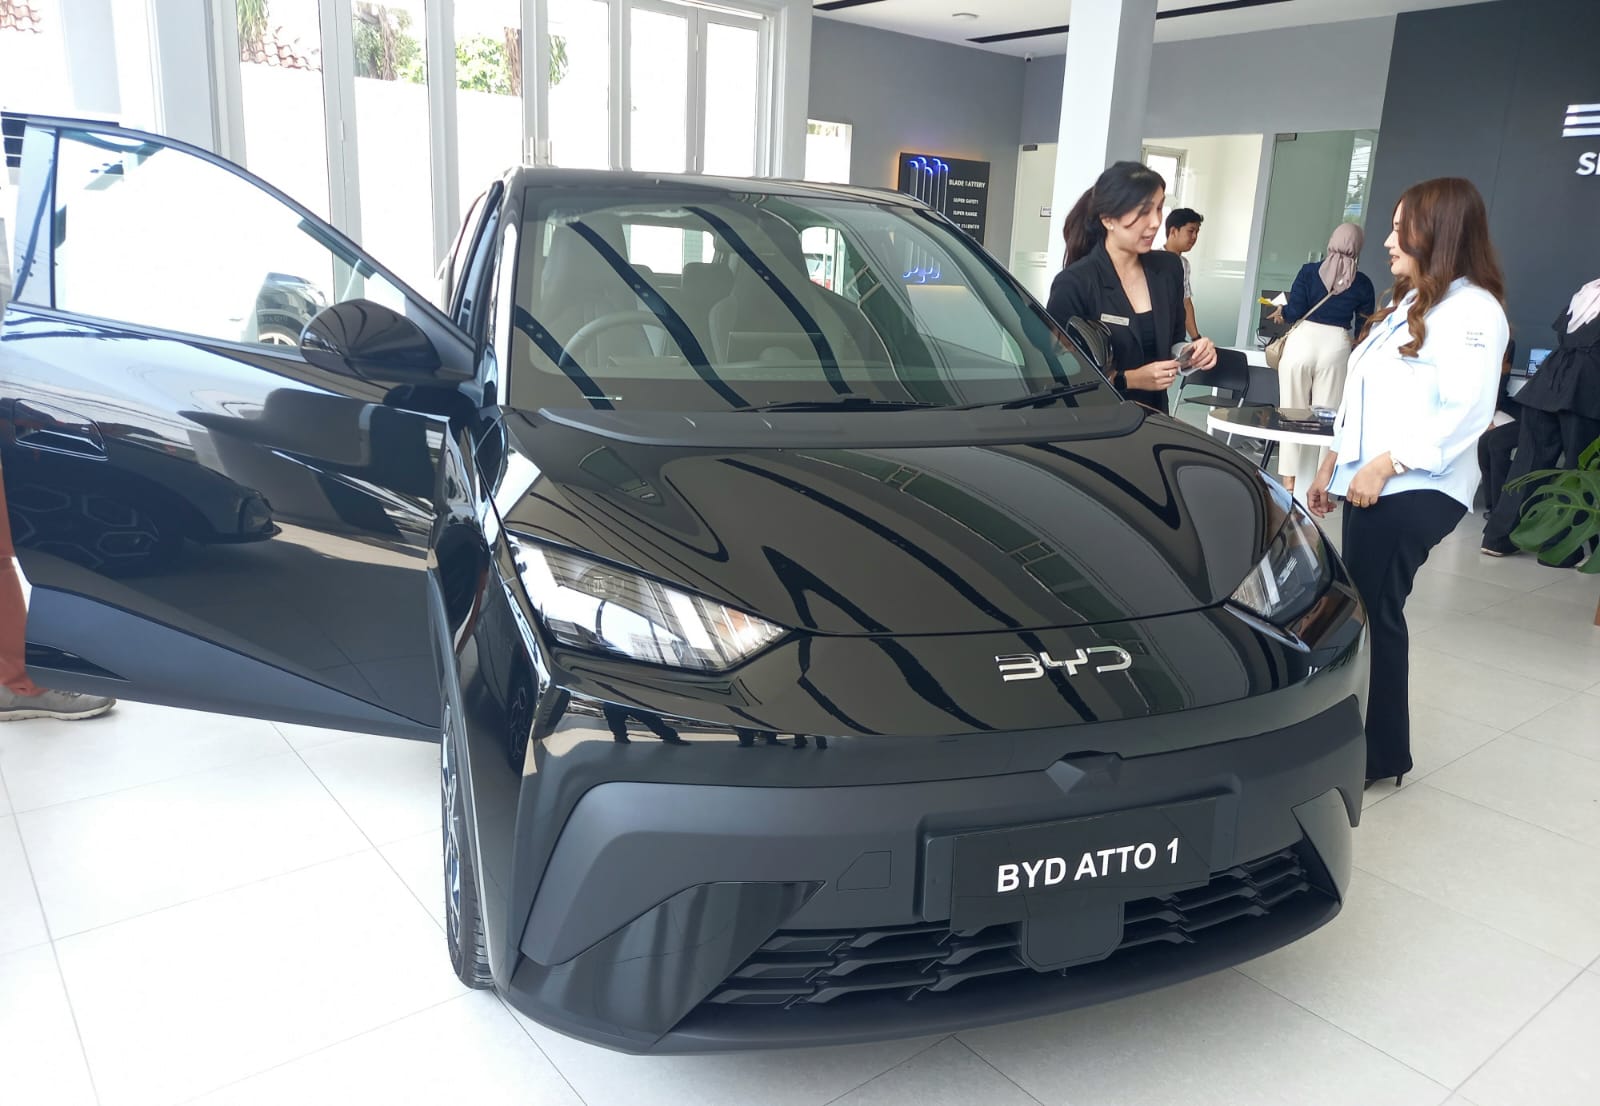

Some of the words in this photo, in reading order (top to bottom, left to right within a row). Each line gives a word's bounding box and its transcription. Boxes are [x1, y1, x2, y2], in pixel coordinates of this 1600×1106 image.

[948, 179, 964, 187] BLADE
[994, 645, 1132, 682] BYD
[997, 857, 1067, 893] BYD
[1073, 842, 1157, 881] ATTO
[1166, 837, 1179, 864] 1
